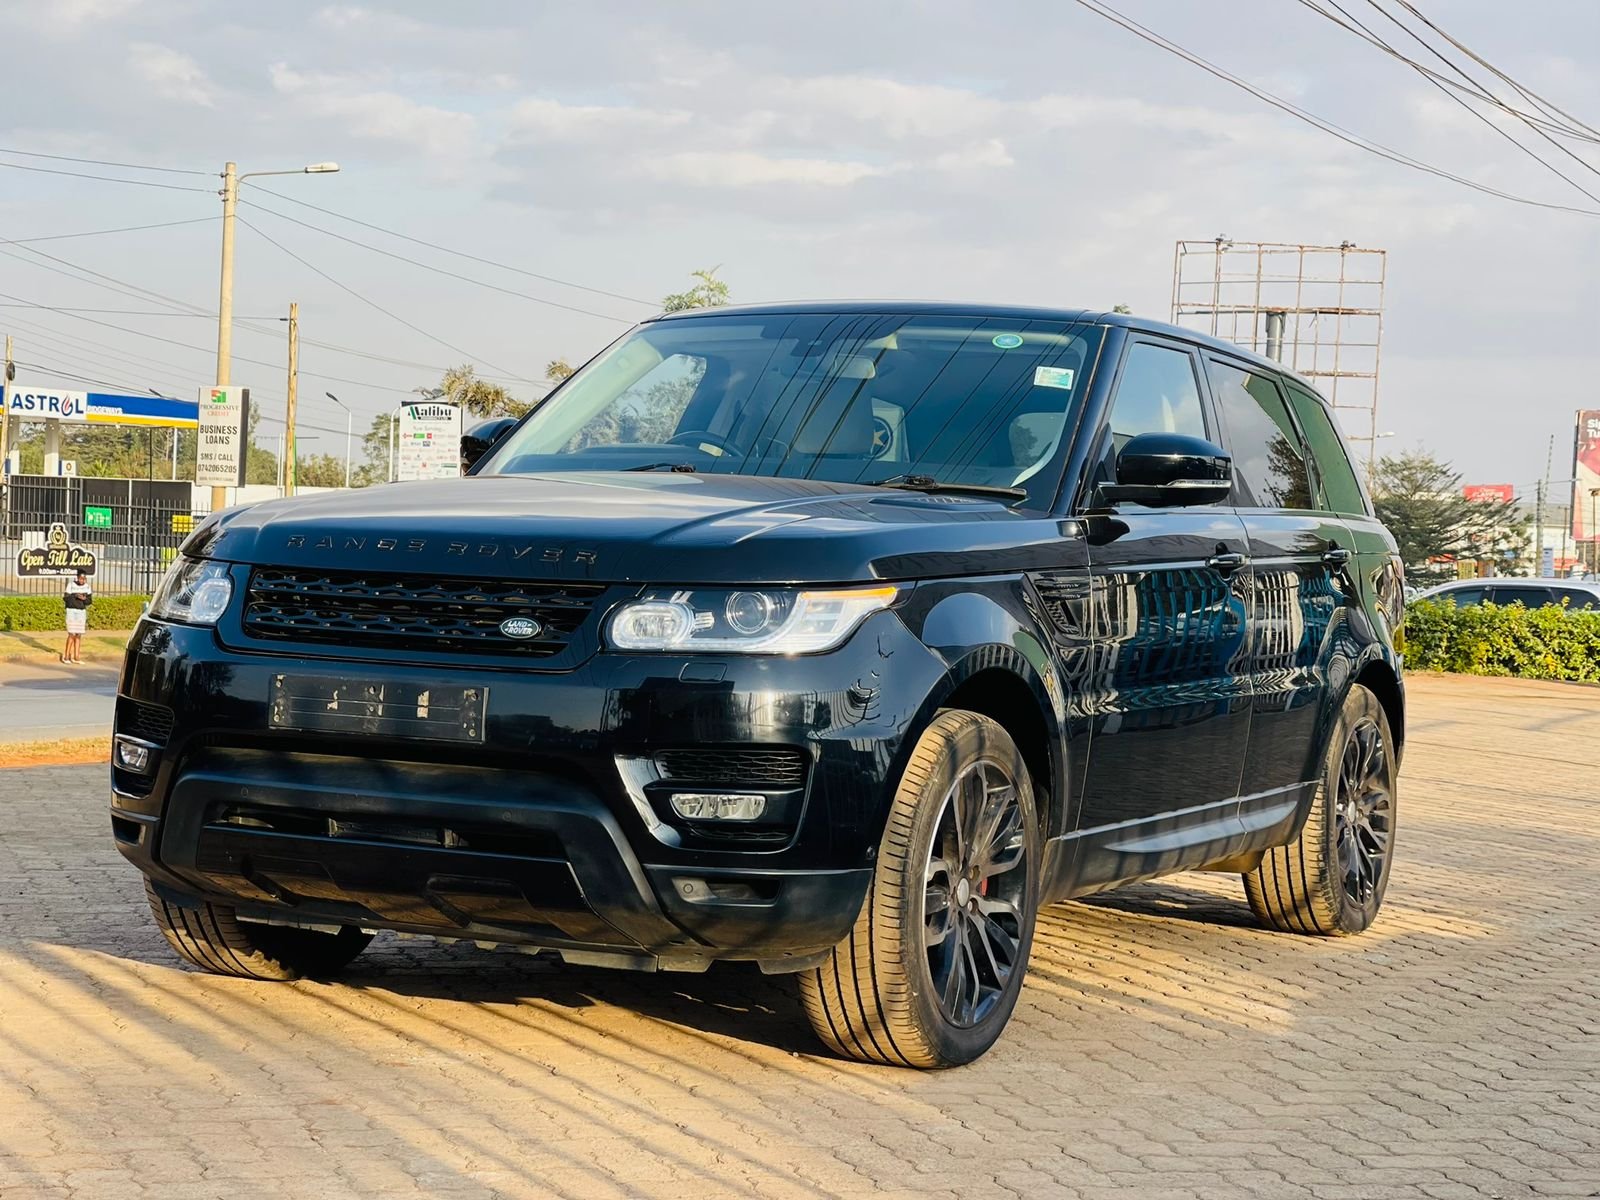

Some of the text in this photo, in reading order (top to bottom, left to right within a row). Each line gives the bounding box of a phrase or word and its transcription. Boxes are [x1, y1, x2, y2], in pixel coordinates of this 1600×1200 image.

[11, 393, 84, 416] ASTROL
[199, 424, 238, 435] BUSINESS
[205, 435, 230, 445] LOANS
[200, 452, 213, 460] SMS
[217, 453, 234, 461] CALL
[286, 534, 598, 565] RANGE ROVER
[21, 550, 93, 571] Open Till Late
